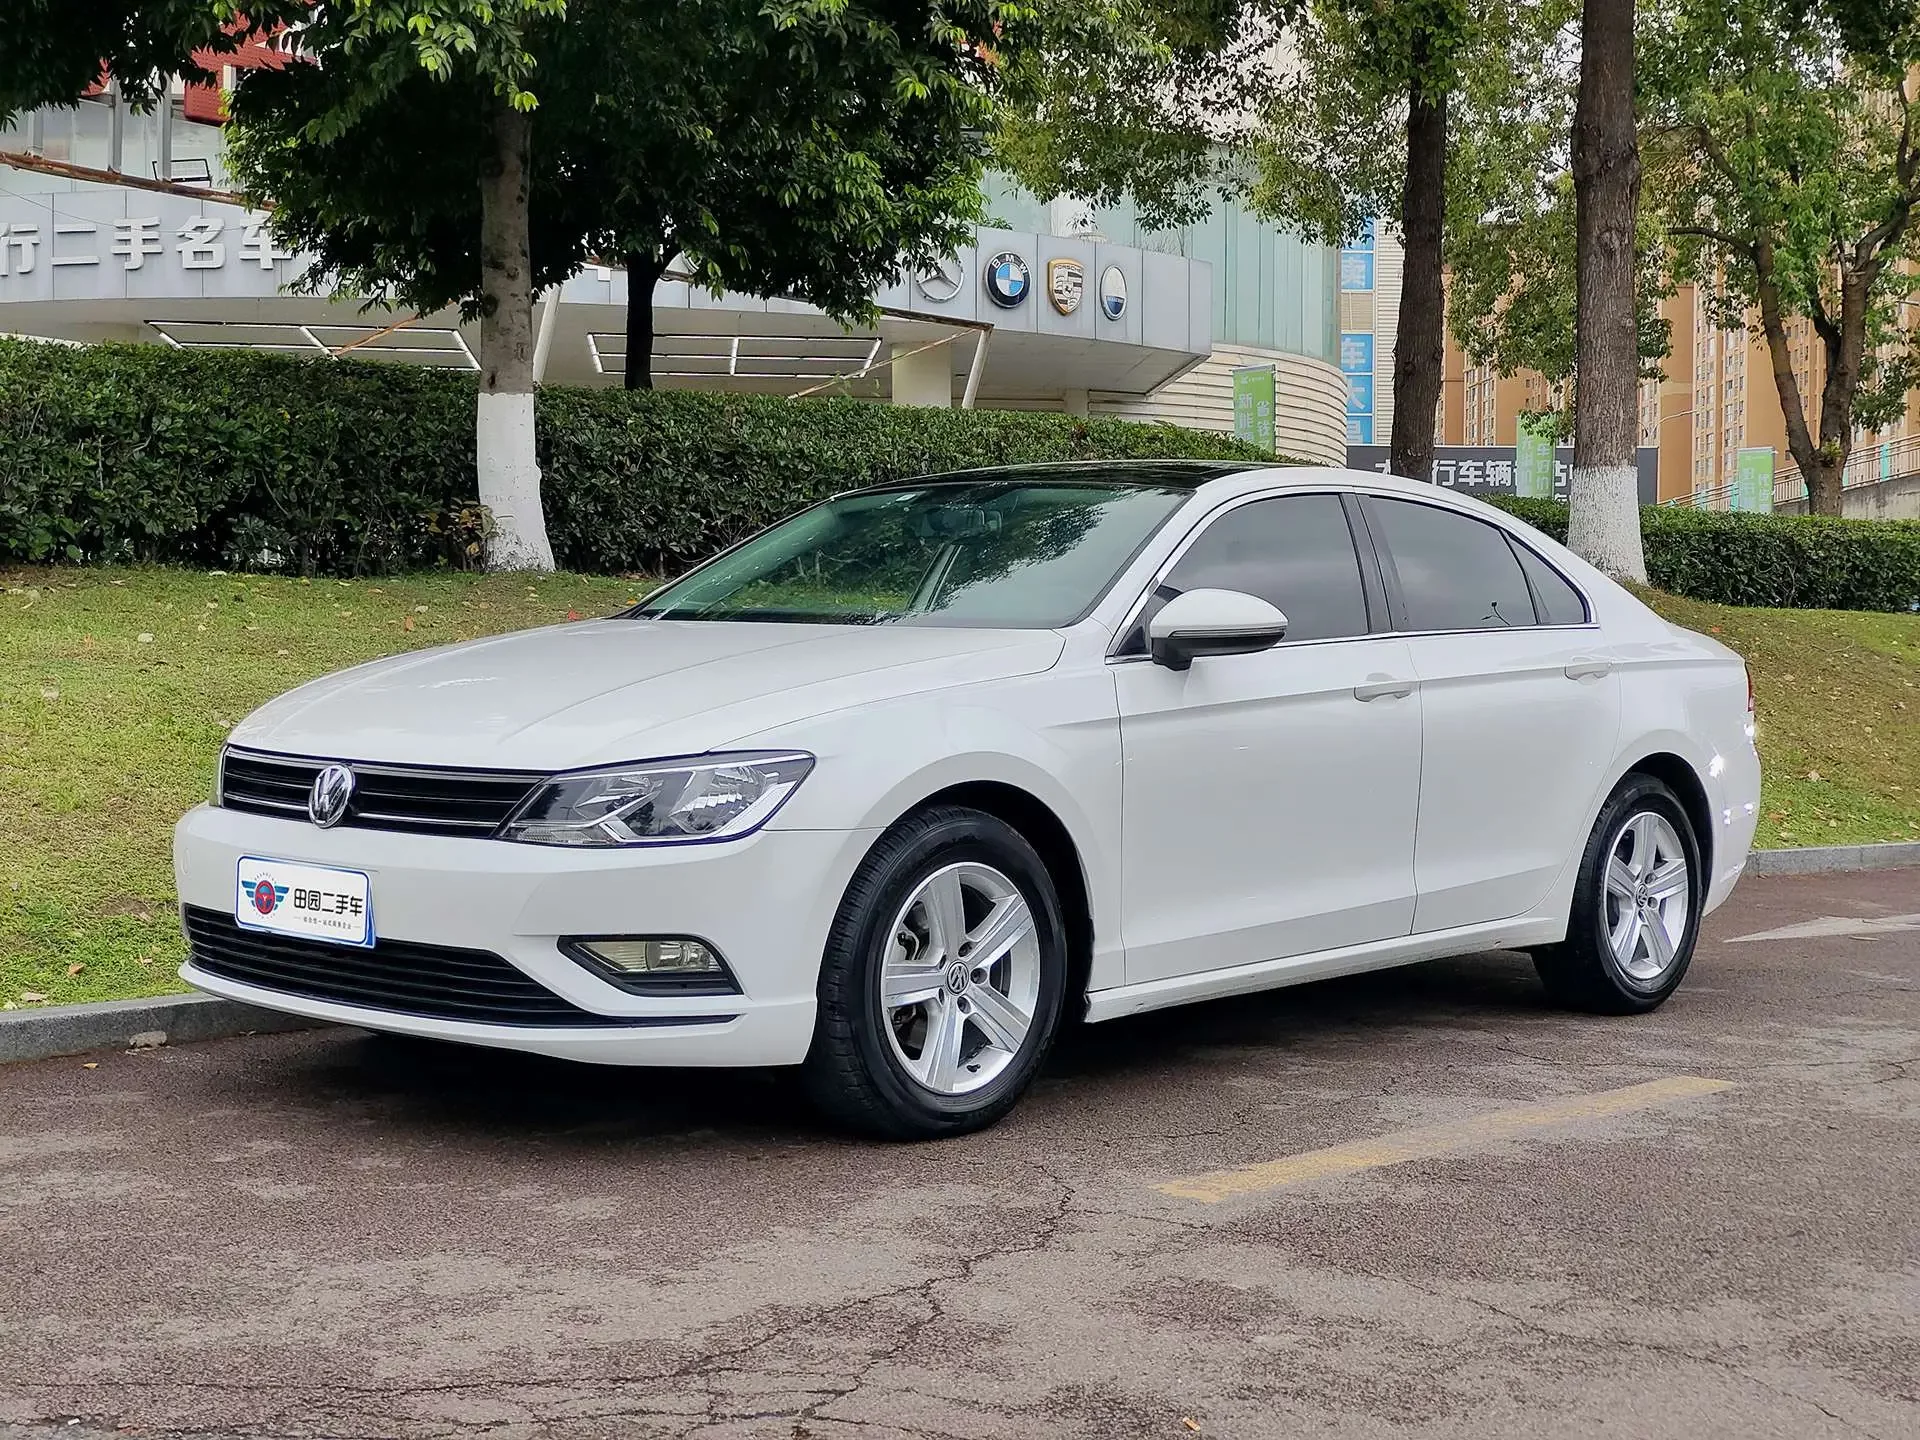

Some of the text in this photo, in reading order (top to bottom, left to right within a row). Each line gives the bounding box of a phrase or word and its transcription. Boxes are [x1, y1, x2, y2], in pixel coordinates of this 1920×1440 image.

[0, 215, 292, 276] 行二手名车
[991, 254, 1029, 275] BMW
[293, 888, 363, 918] 田园二手车
